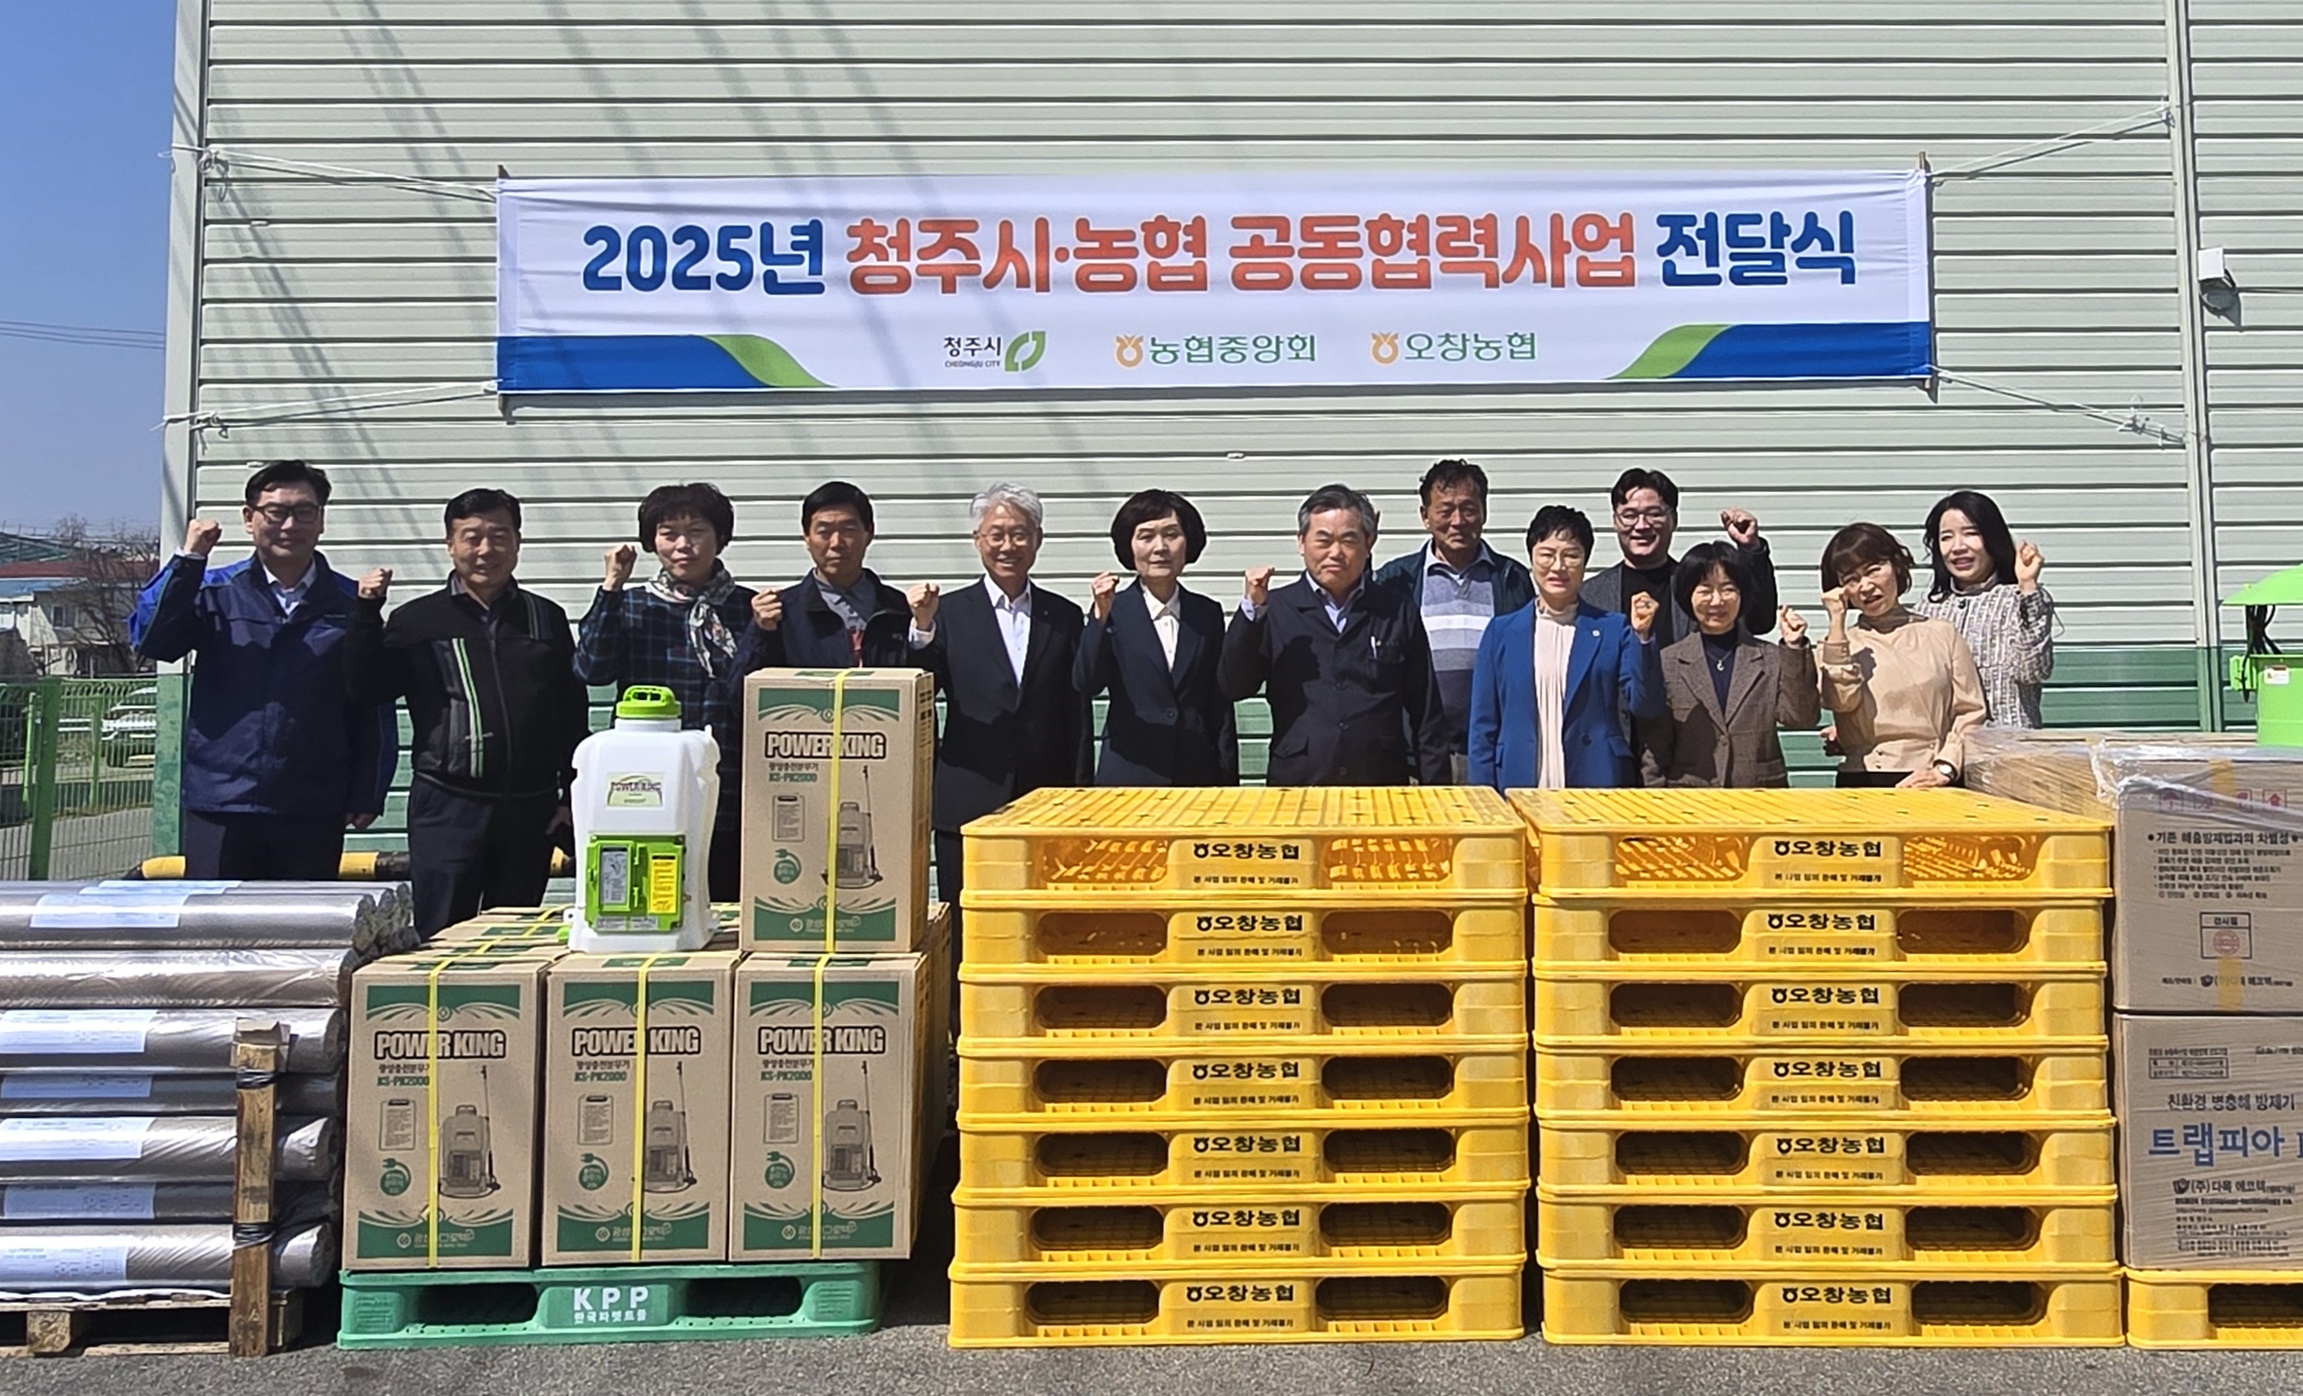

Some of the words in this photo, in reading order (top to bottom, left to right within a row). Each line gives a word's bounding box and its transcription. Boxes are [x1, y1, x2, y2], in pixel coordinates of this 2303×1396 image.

[583, 218, 825, 295] 2025년
[846, 216, 1208, 294] 청주시·농협
[1229, 211, 1635, 290] 공동협력사업
[1655, 209, 1856, 287] 전달식
[943, 336, 1002, 357] 청주시
[1150, 335, 1315, 364] 농협중앙회
[1405, 332, 1536, 362] 오창농협
[945, 360, 983, 368] CHEONGJU
[765, 731, 834, 759] POWER
[839, 731, 887, 759] KING
[1210, 842, 1299, 860] 오창농협
[1791, 839, 1882, 858] 오창농협
[1213, 914, 1303, 932] 오창농협
[1784, 913, 1875, 931] 오창농협
[1211, 987, 1300, 1005] 오창농협
[1789, 987, 1879, 1005] 오창농협
[374, 1030, 452, 1060] POWR
[453, 1030, 507, 1059] KING
[572, 1027, 642, 1057] POWE
[648, 1025, 701, 1055] KING
[834, 1025, 886, 1055] KING
[1209, 1061, 1299, 1079] 오창농협
[1790, 1060, 1881, 1078] 오창농협
[2168, 1093, 2206, 1111] 친환경
[2211, 1093, 2251, 1111] 병충해
[2255, 1093, 2295, 1111] 방제기
[1210, 1135, 1301, 1153] 오창농협
[1793, 1136, 1885, 1155] 오창농협
[2148, 1122, 2286, 1167] 트랩피아
[1210, 1209, 1300, 1227] 오창농협
[1791, 1212, 1884, 1231] 오창농협
[573, 1286, 649, 1311] KPP
[1203, 1284, 1294, 1302] 오창농협
[1799, 1286, 1891, 1305] 오창농협
